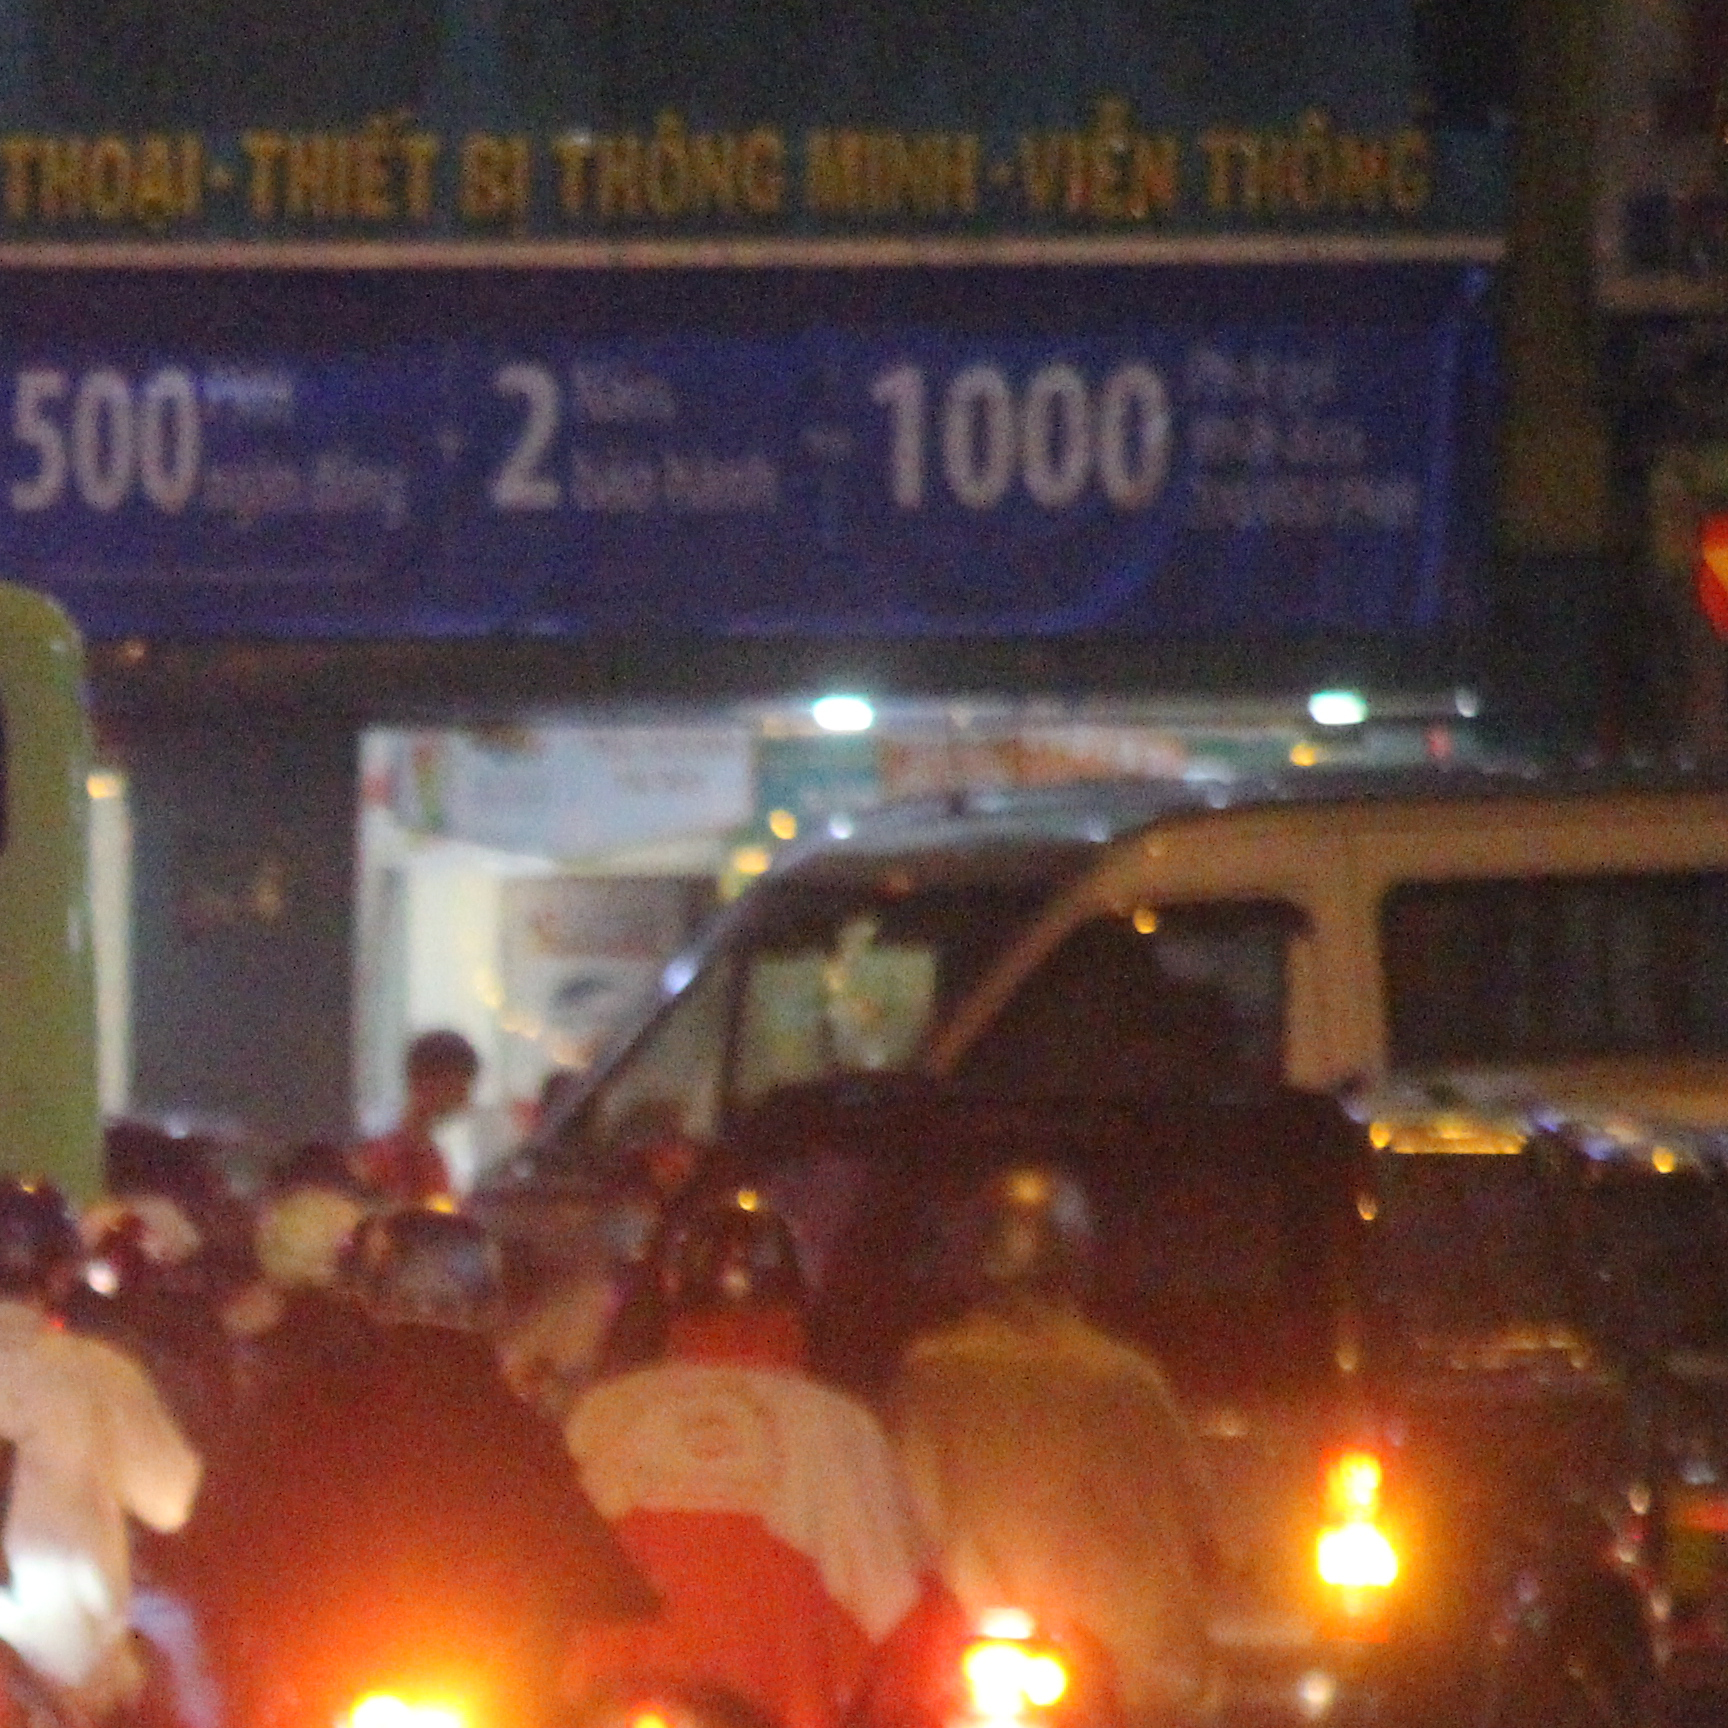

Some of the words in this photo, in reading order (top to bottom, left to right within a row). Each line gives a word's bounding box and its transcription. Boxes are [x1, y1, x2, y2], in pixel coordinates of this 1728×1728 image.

[10, 364, 202, 514] 500
[490, 361, 562, 512] 2
[870, 360, 1170, 511] 1000
